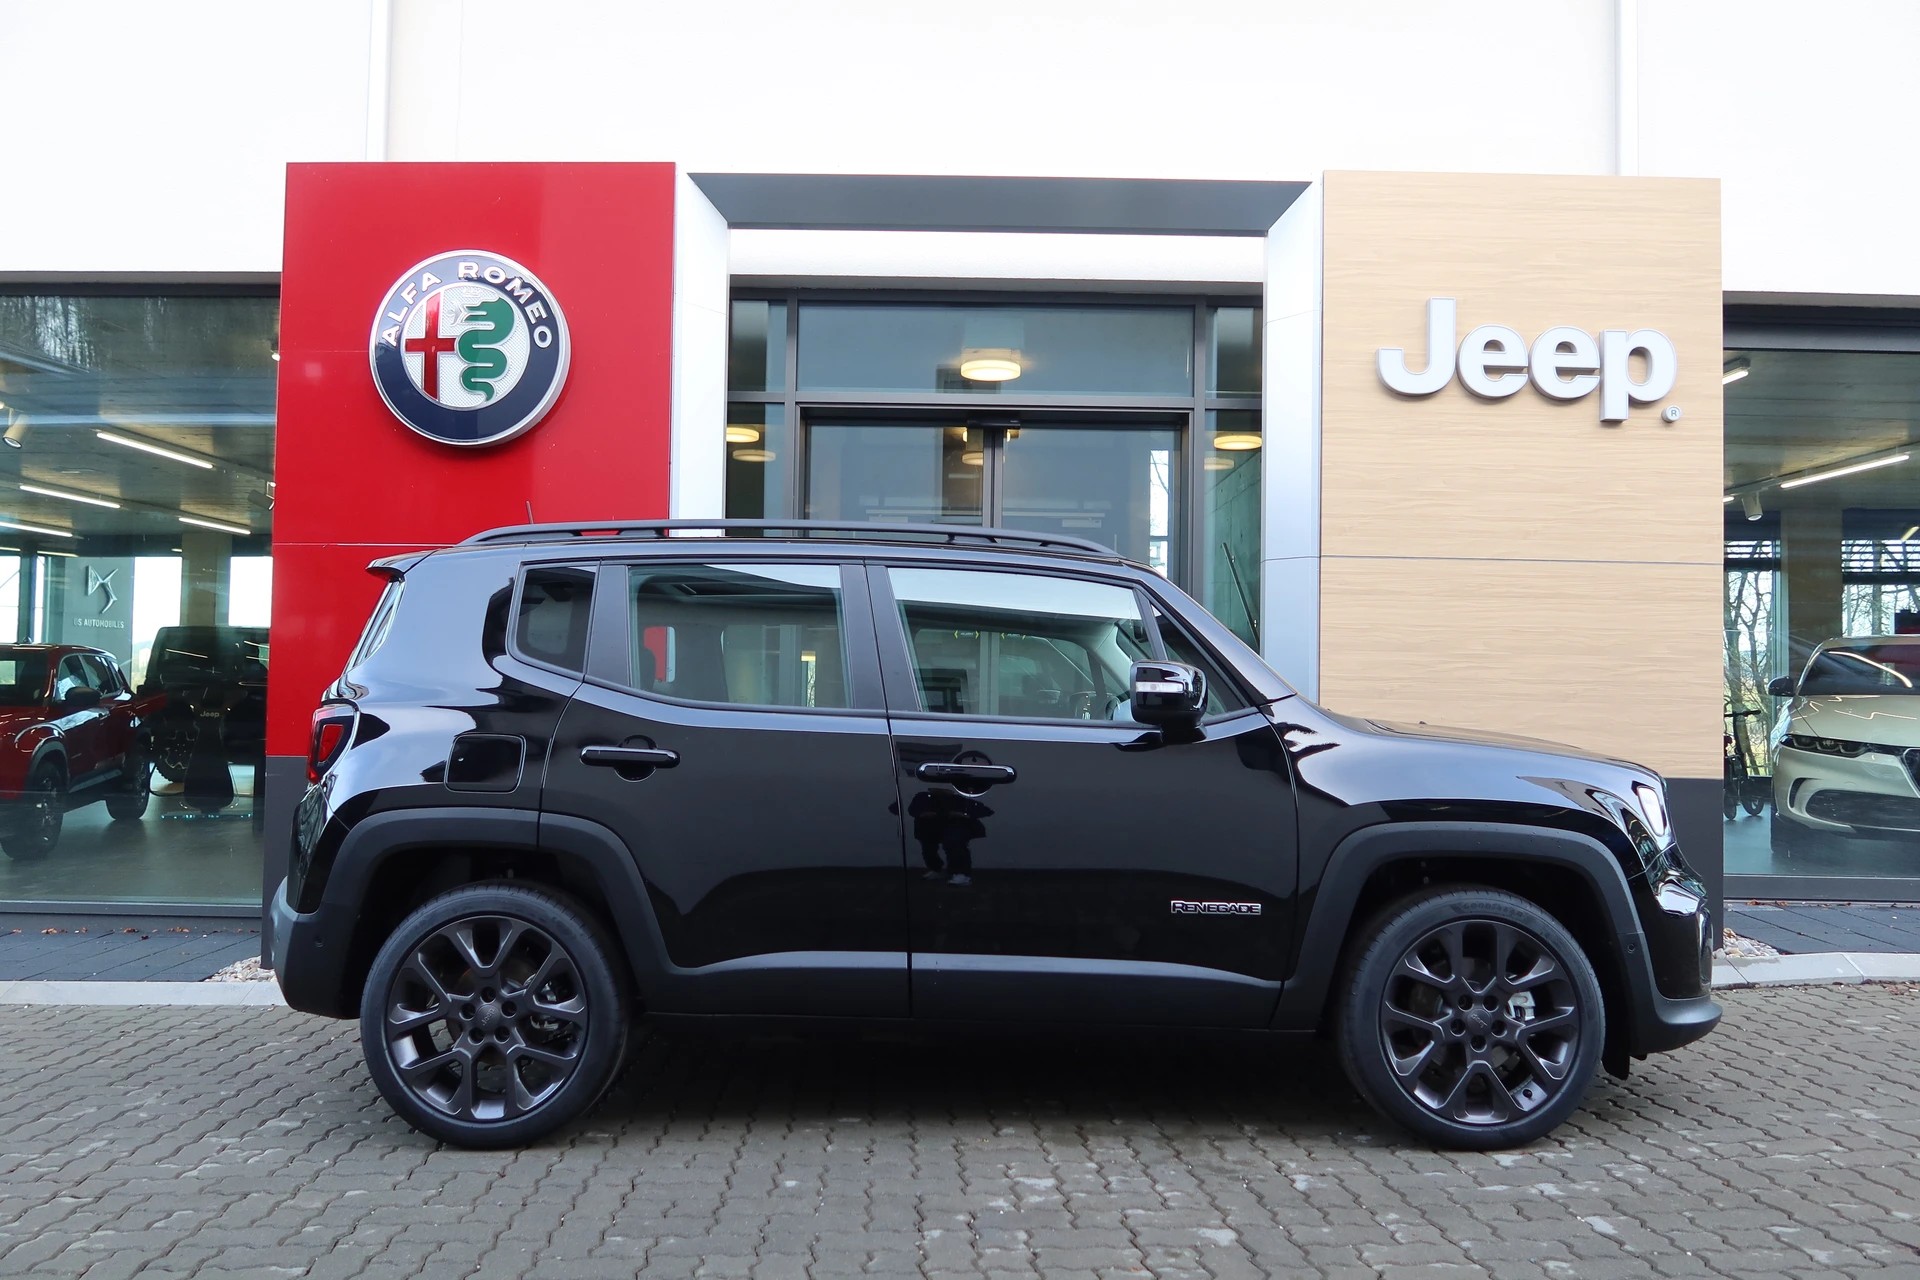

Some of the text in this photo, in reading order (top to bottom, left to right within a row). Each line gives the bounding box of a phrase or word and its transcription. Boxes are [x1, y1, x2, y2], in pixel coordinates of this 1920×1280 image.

[382, 262, 552, 349] ALFA ROMEO
[1376, 297, 1677, 422] Jeep
[1171, 901, 1261, 915] RENEGADE
